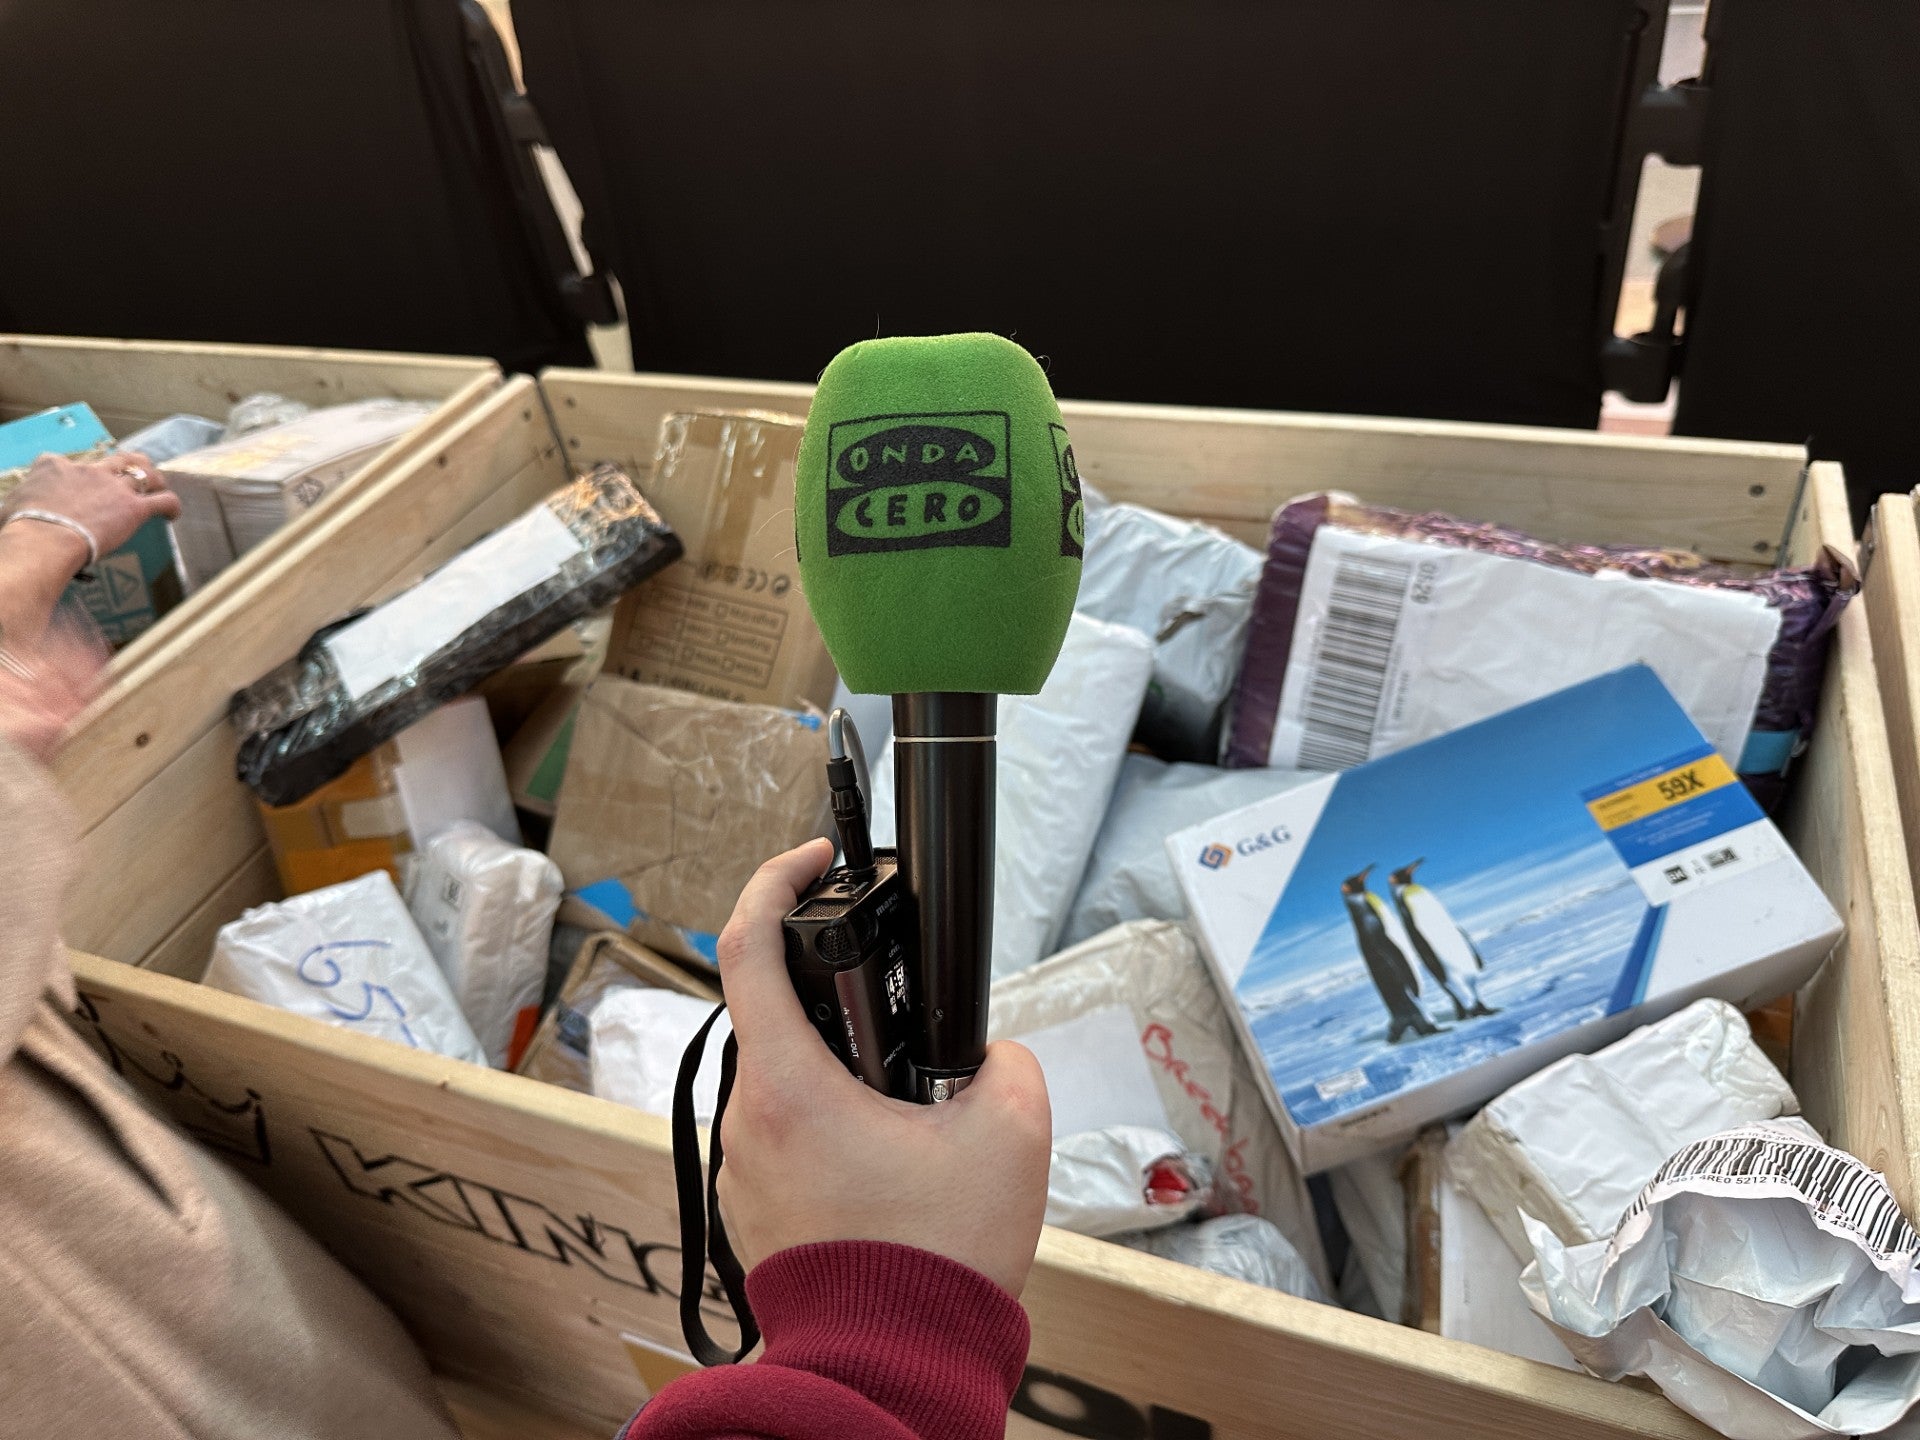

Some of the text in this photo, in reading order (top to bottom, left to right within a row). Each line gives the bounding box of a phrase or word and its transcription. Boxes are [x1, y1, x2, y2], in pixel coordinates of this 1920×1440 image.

[849, 441, 980, 472] ONDA
[854, 492, 981, 528] CERO
[1656, 769, 1706, 801] 59X
[1236, 824, 1292, 857] G&G
